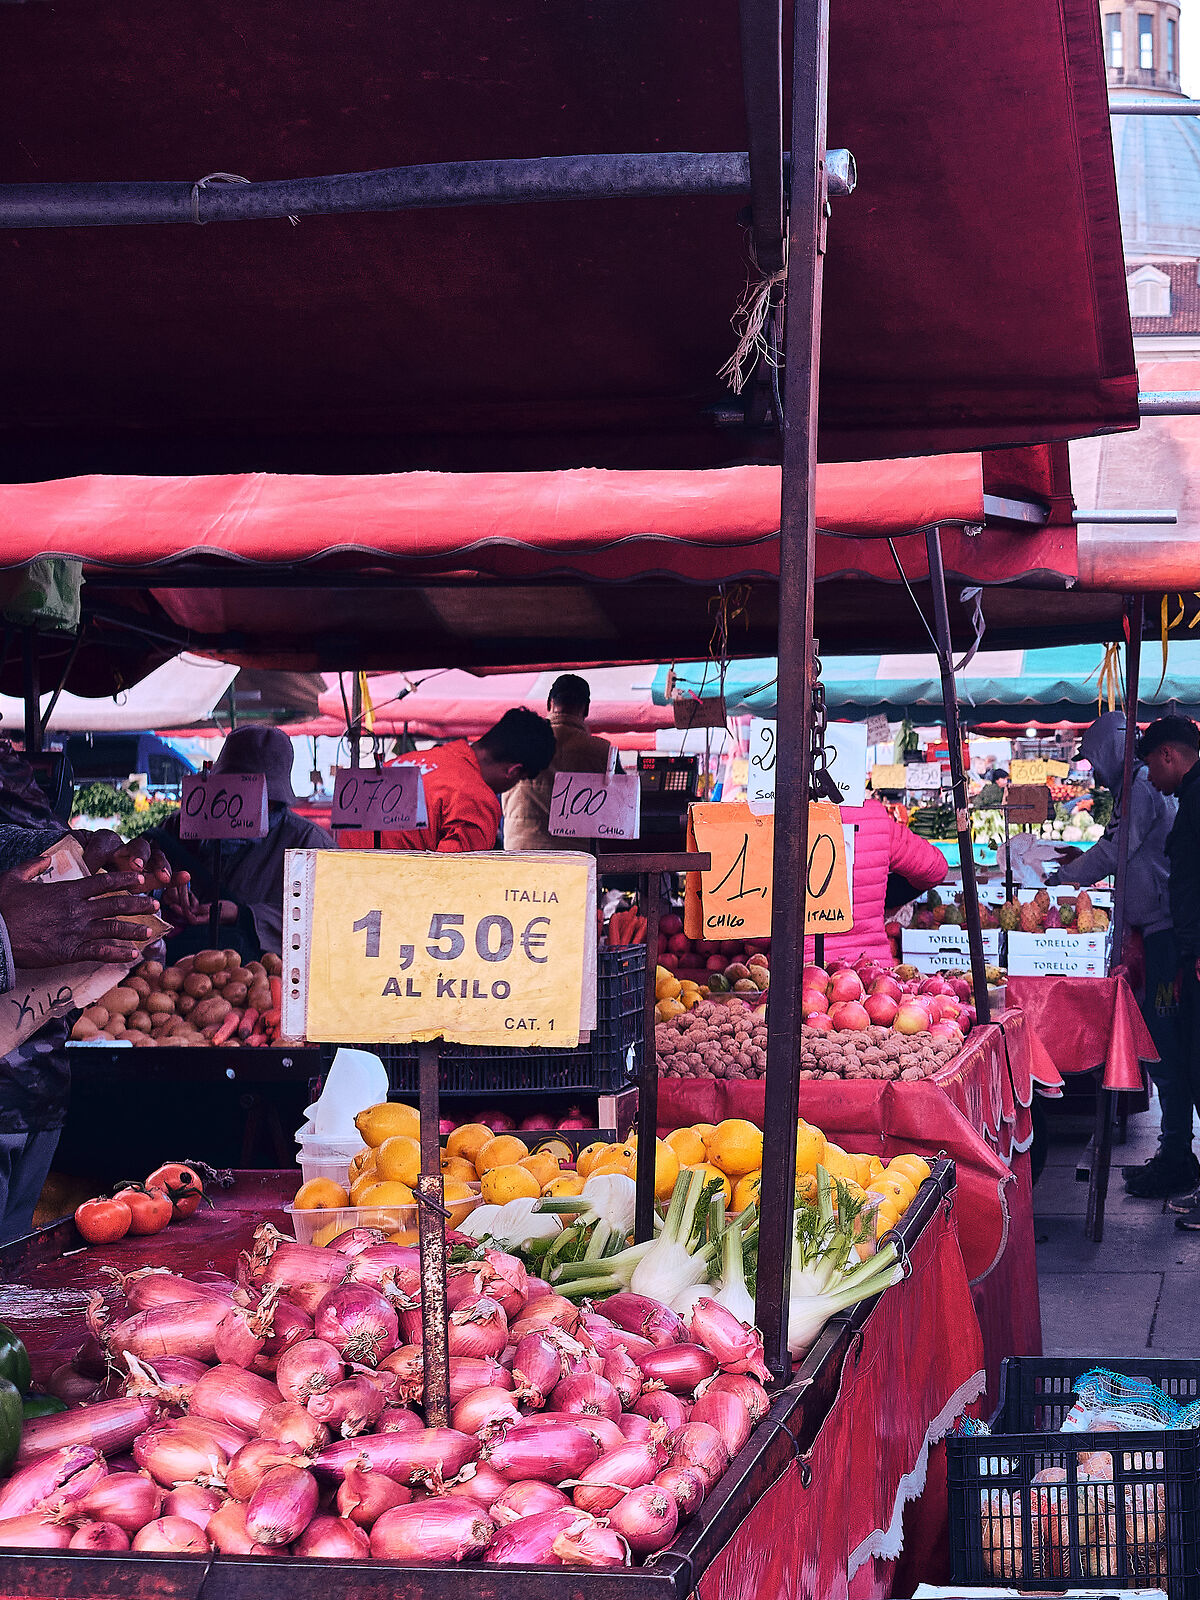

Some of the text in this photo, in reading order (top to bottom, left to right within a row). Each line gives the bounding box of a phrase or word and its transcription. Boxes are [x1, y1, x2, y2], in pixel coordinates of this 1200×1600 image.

[339, 778, 403, 814] 0,70
[552, 776, 608, 820] 1,00
[598, 824, 625, 836] CHILO
[504, 889, 560, 904] ITALIA
[706, 908, 845, 928] CHILO ITALIA
[1034, 939, 1080, 948] TORELLO
[1033, 961, 1078, 971] TORELLO
[381, 975, 511, 1000] AL KILO
[504, 1017, 556, 1031] CAT. 1
